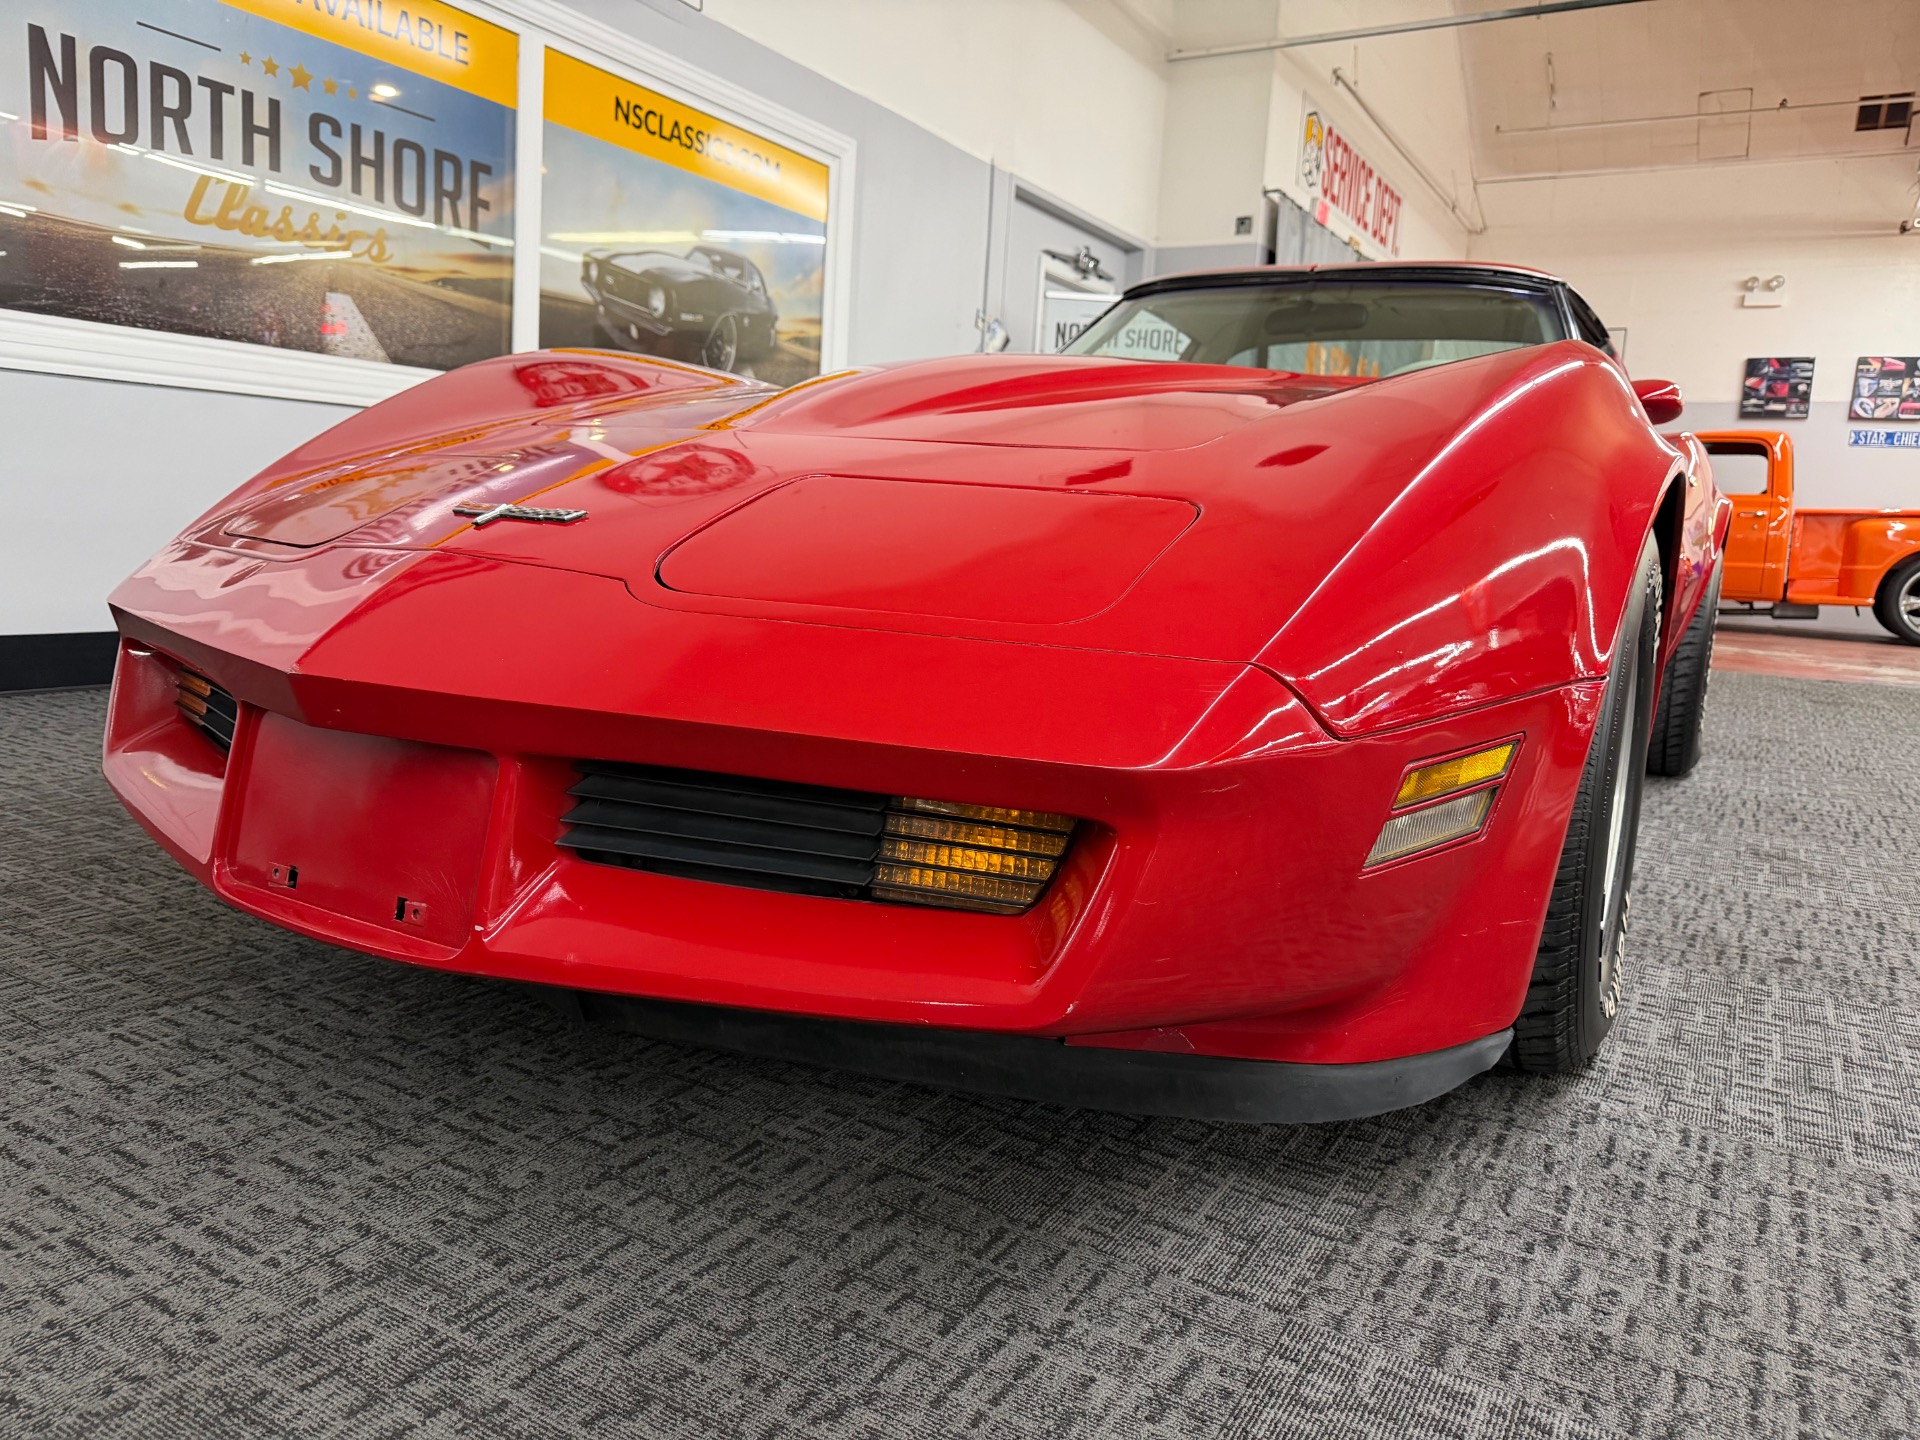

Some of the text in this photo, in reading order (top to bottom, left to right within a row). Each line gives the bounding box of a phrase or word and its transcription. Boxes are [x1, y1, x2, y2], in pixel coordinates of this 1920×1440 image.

[296, 0, 469, 66] VAILABLE
[27, 22, 493, 251] NORTH SHORE
[1321, 125, 1374, 232] SERVICE
[184, 174, 395, 263] Classics
[1124, 328, 1183, 355] SHORE
[1858, 431, 1886, 445] STAR
